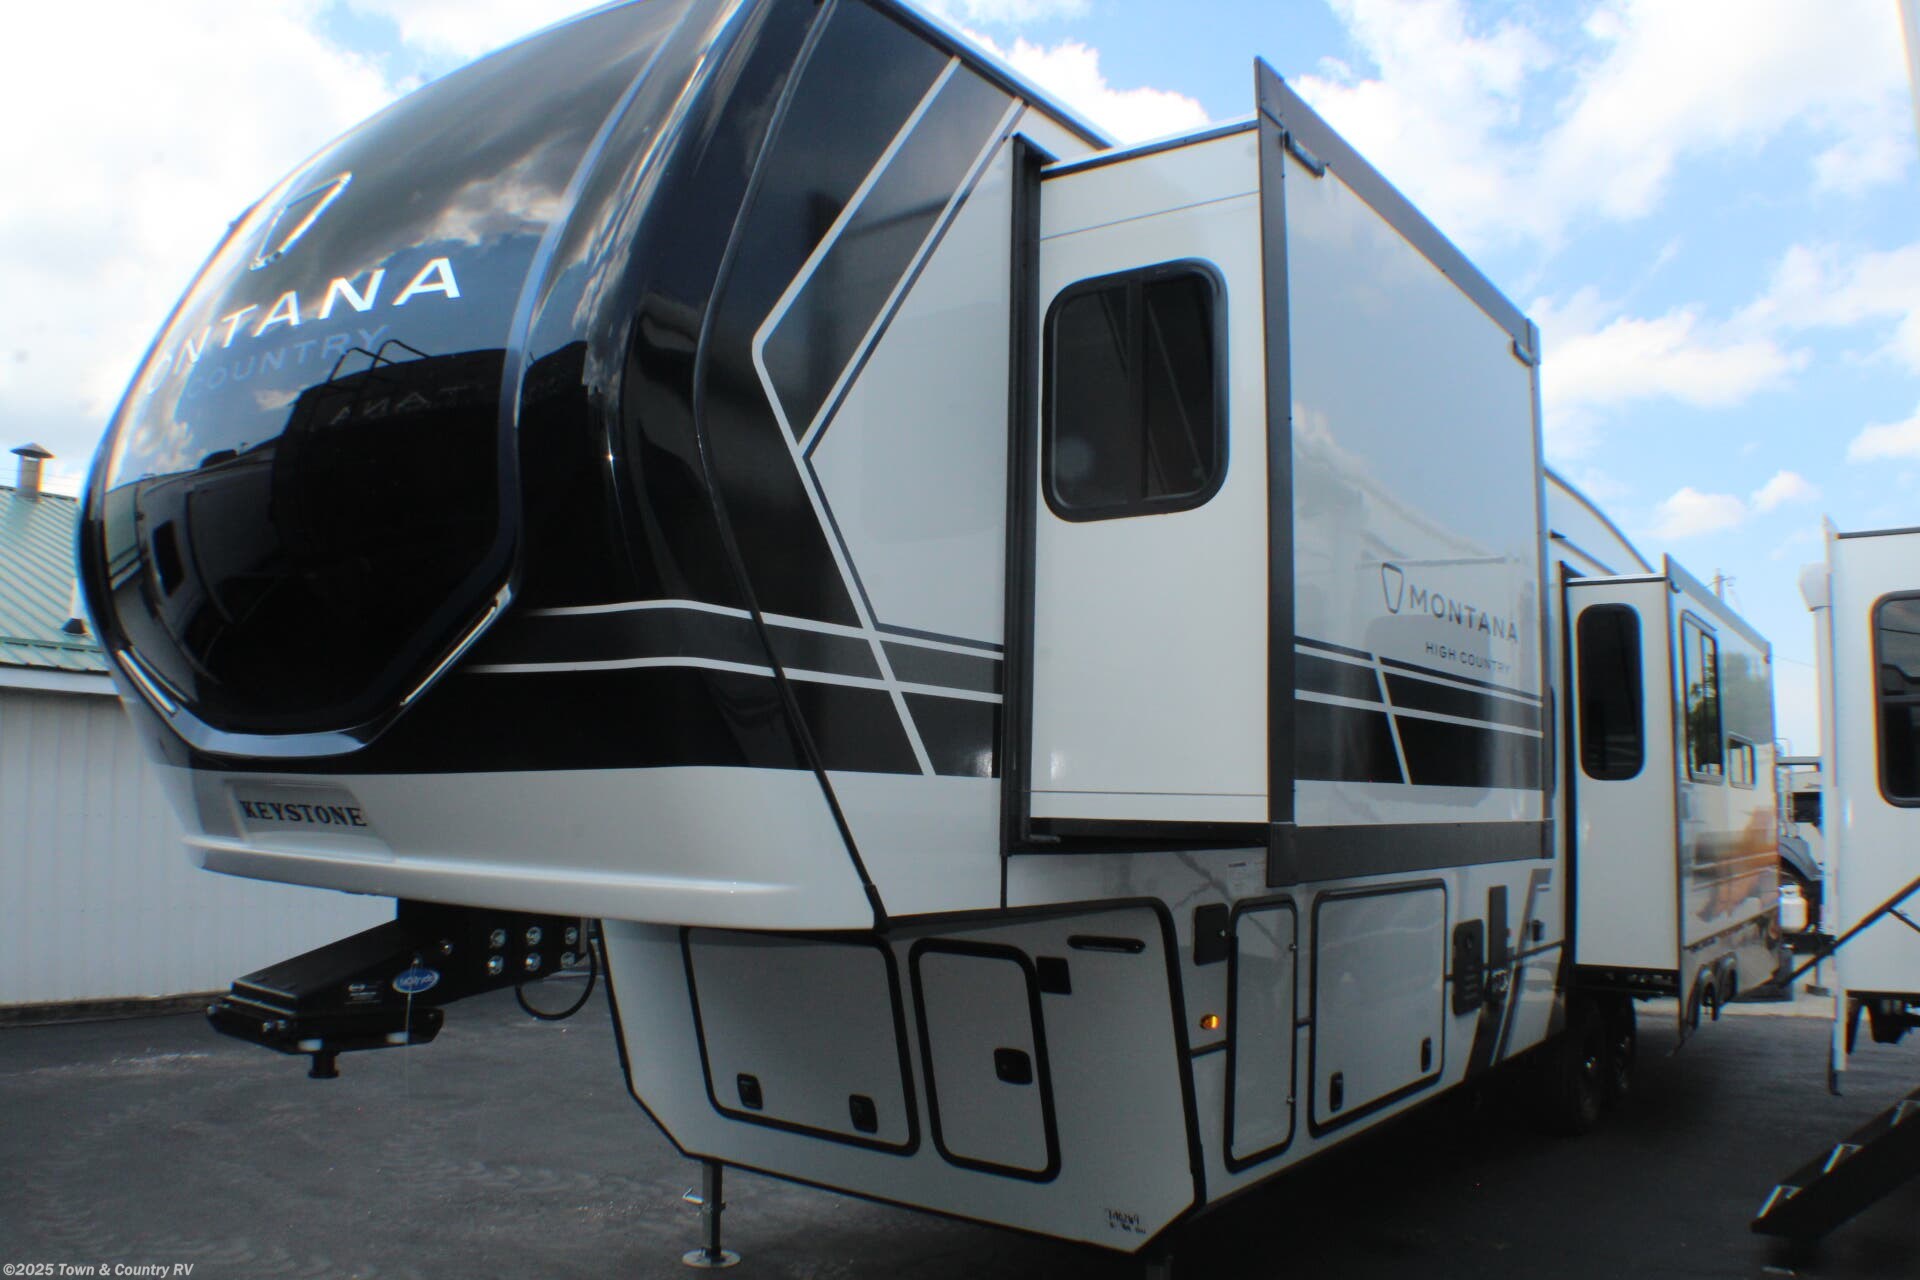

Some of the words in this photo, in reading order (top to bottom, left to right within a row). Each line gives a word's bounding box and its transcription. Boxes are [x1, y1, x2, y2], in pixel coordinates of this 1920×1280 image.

[148, 257, 461, 394] ONTANA
[187, 325, 389, 398] COUNTRY
[1410, 584, 1518, 642] MONTANA
[1426, 642, 1456, 661] HIGH
[1460, 653, 1511, 673] COUNTRY
[240, 800, 367, 827] KEYSTONE
